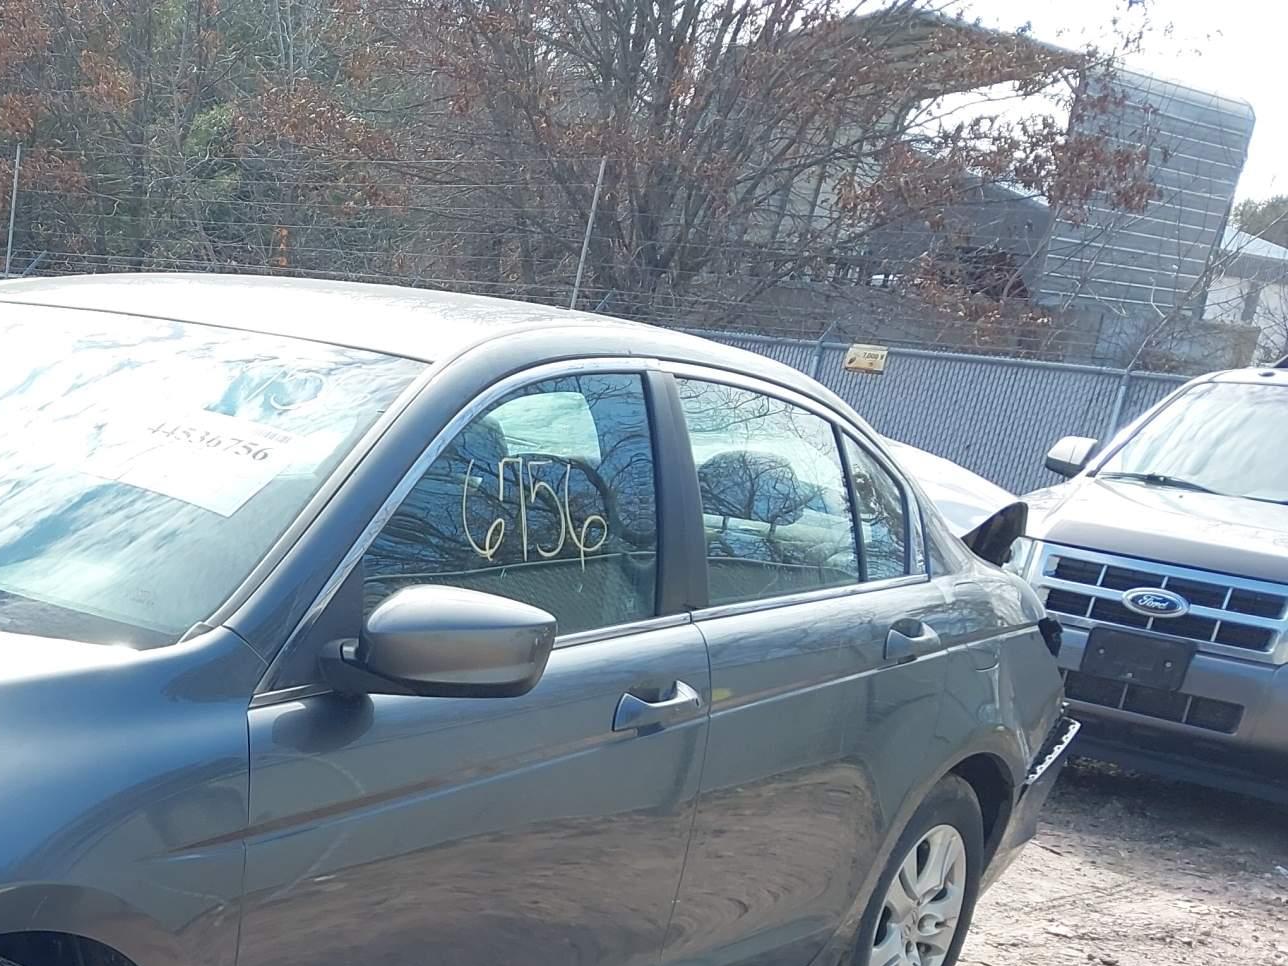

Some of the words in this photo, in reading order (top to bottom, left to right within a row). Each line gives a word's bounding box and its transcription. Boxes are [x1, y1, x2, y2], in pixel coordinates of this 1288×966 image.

[147, 421, 276, 462] 44536756
[462, 456, 609, 574] 6756
[1137, 595, 1170, 610] Ford
